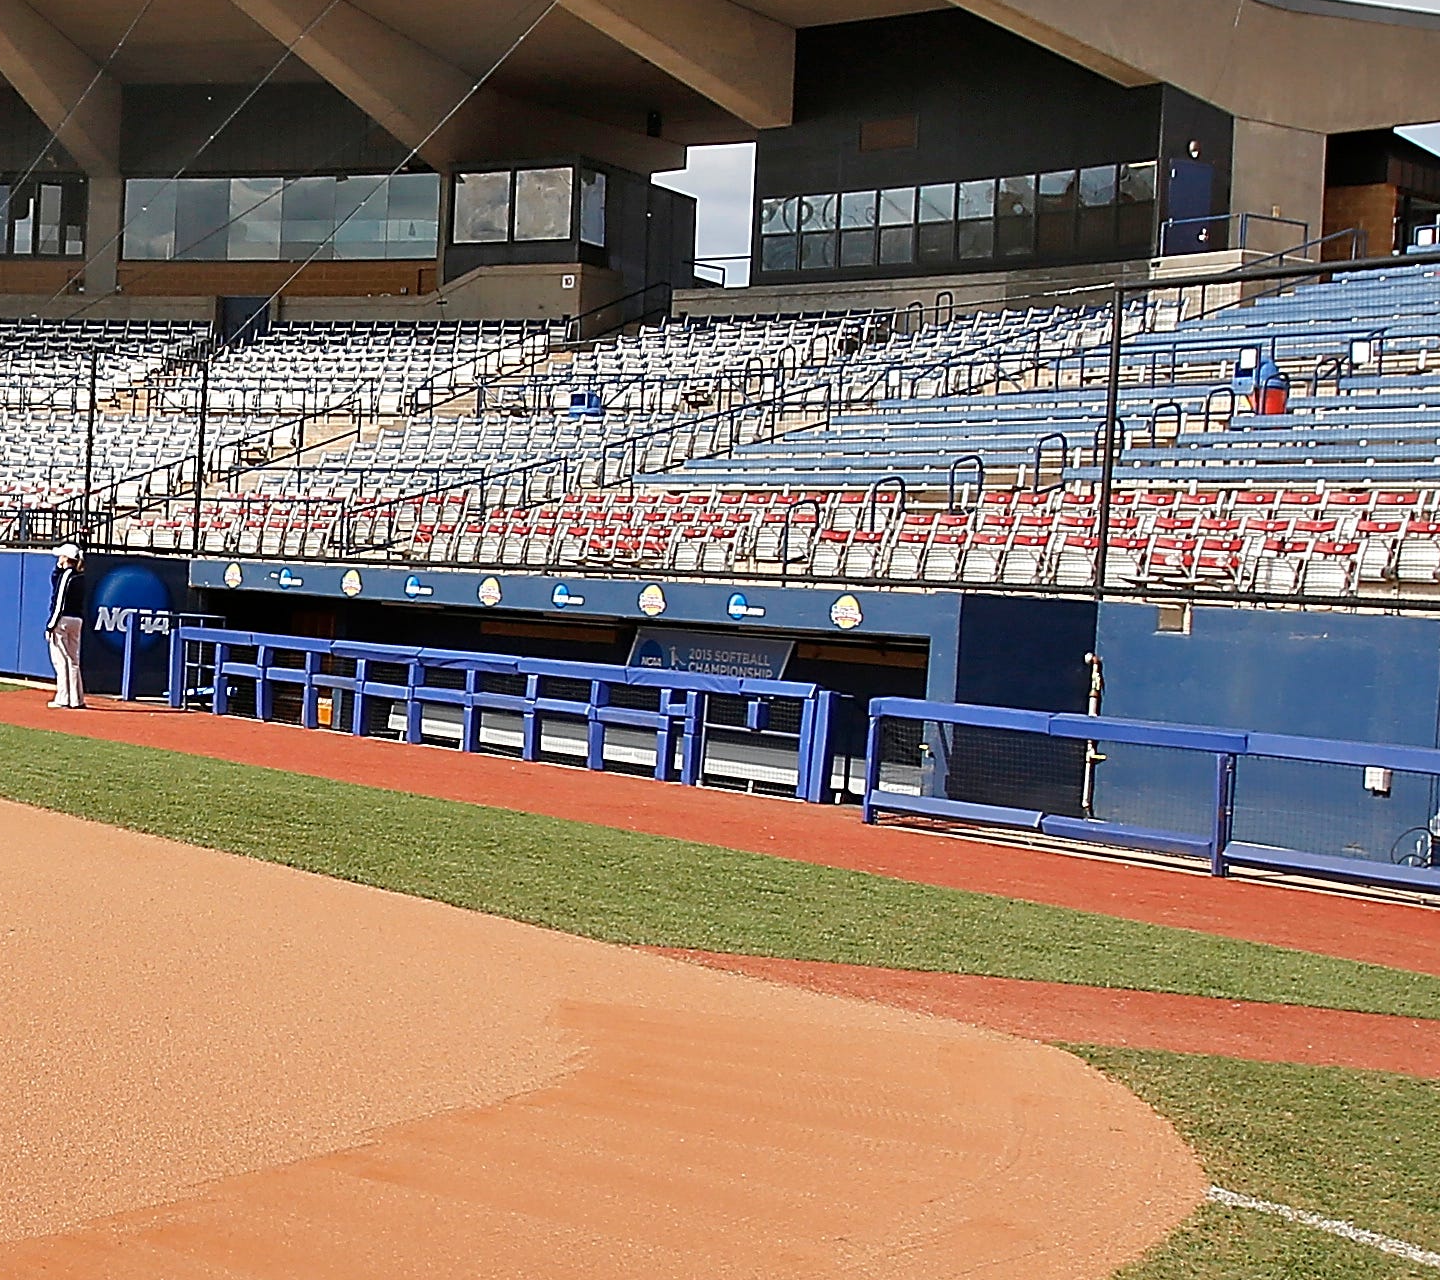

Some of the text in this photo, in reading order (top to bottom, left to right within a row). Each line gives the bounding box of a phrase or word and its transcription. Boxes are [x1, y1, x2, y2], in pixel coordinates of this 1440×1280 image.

[689, 648, 771, 666] 2015 SOFTBALL
[687, 662, 773, 679] CHAMPIONSHIP
